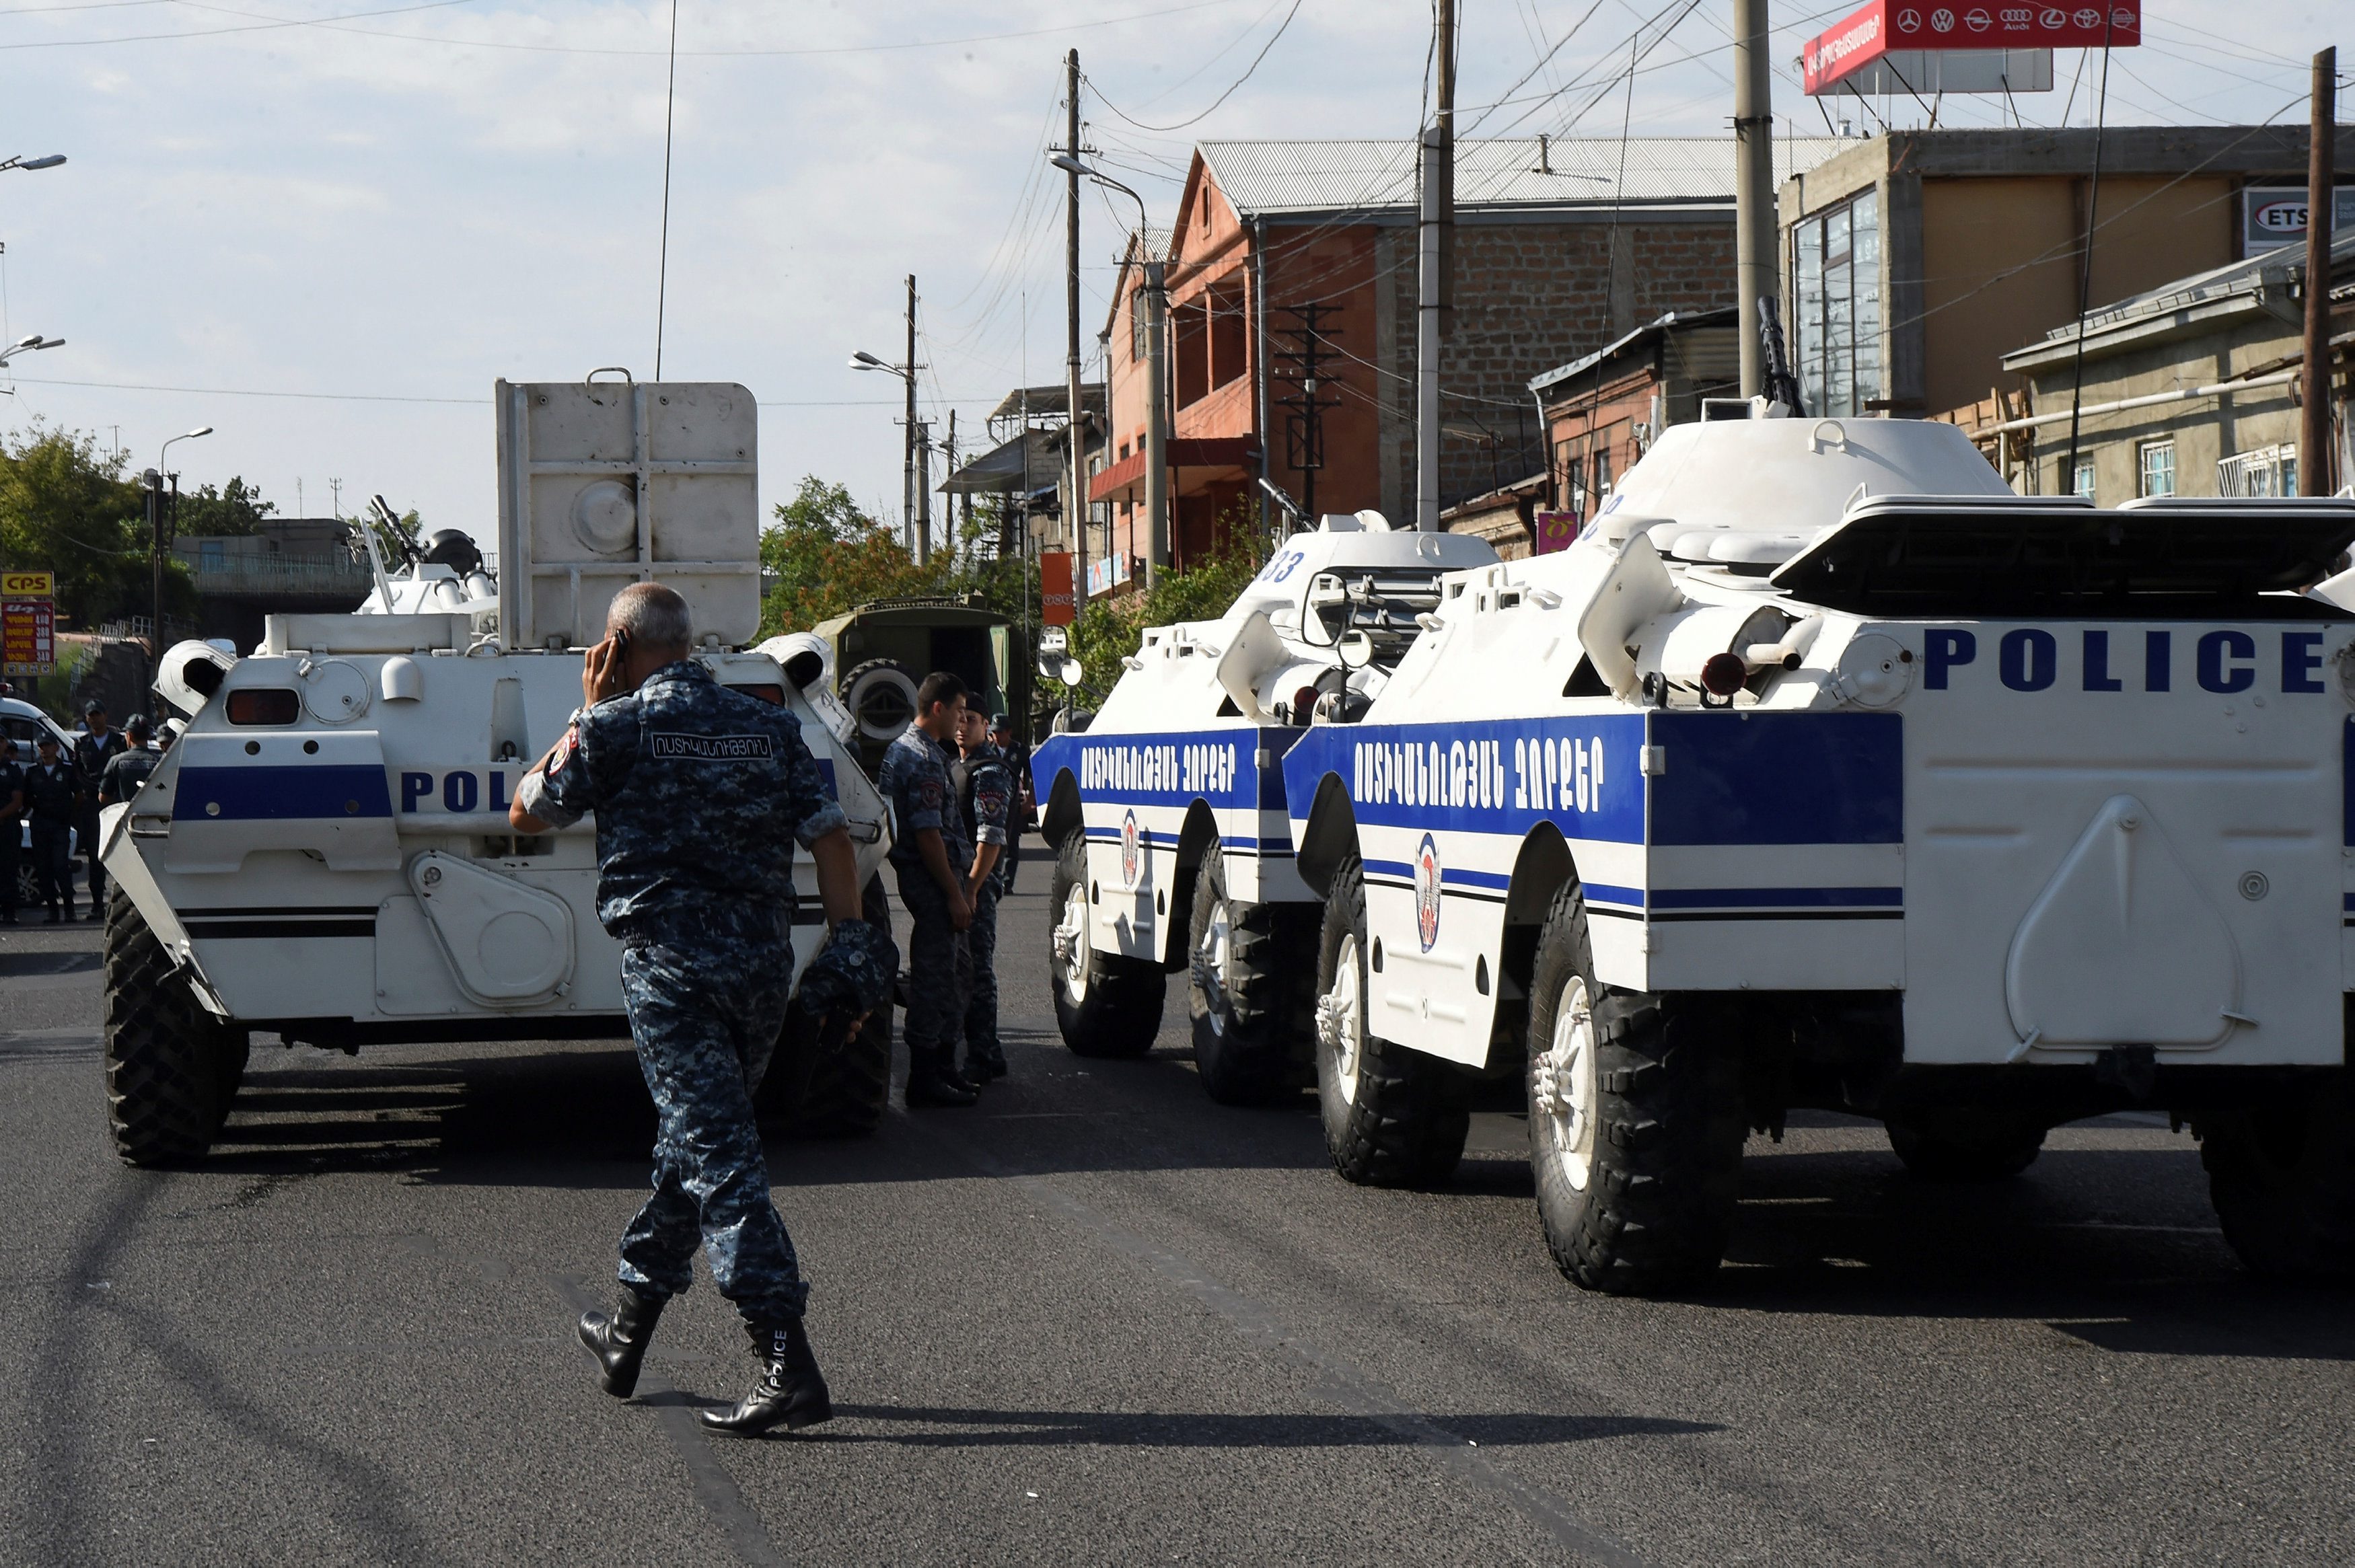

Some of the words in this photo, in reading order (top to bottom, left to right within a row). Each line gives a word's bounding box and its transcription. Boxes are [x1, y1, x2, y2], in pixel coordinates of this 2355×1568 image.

[2004, 22, 2029, 30] Audi
[7, 576, 46, 590] CPS
[1044, 595, 1072, 605] TNT
[1924, 628, 2325, 694] POLICE
[656, 737, 768, 756] ՈՍՏԻԿԱՆՈՒԹՅՈՒՆ
[1183, 743, 1235, 793] ԶՈՐՔԵՐ
[1515, 736, 1604, 814] ԶՈՐՔԵՐ
[402, 771, 528, 813] POL
[770, 1330, 787, 1388] POLICE
